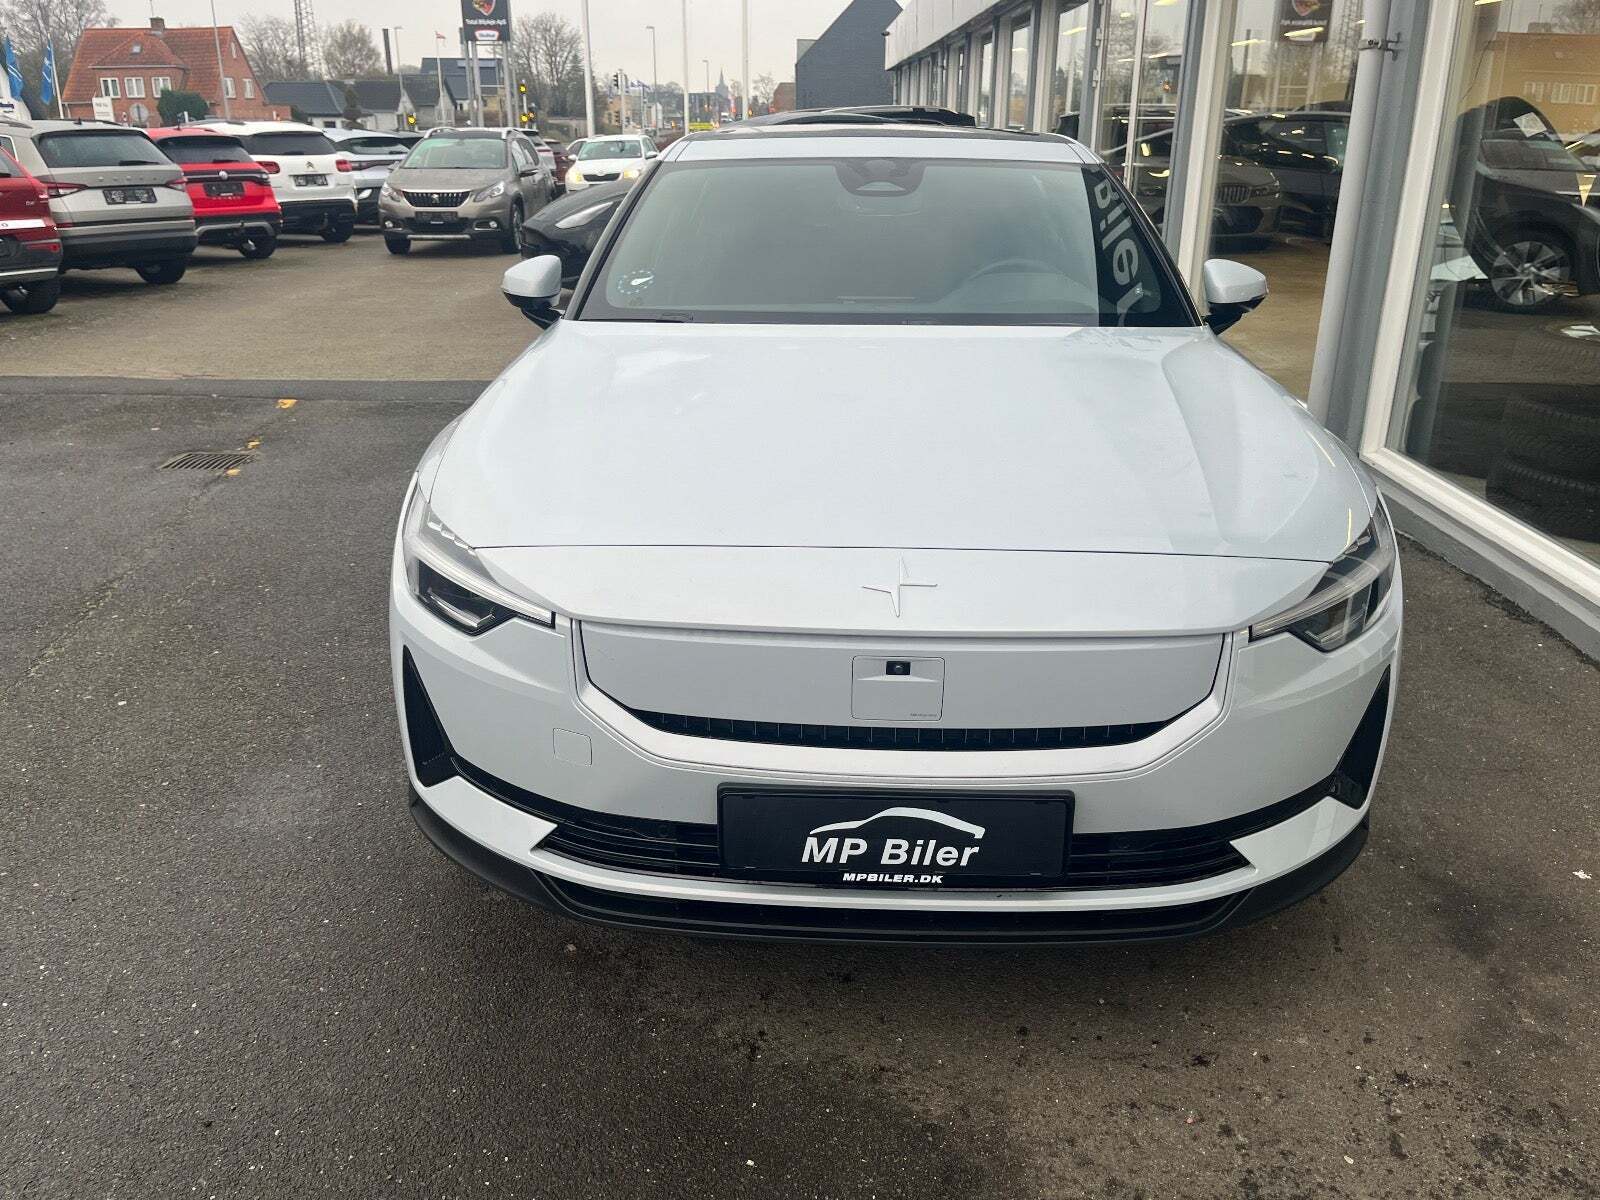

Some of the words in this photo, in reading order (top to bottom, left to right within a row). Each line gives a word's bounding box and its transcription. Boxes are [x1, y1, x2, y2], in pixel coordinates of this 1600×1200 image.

[802, 837, 868, 864] MP
[881, 839, 980, 867] Biler
[842, 873, 943, 884] MPBILER.DK
